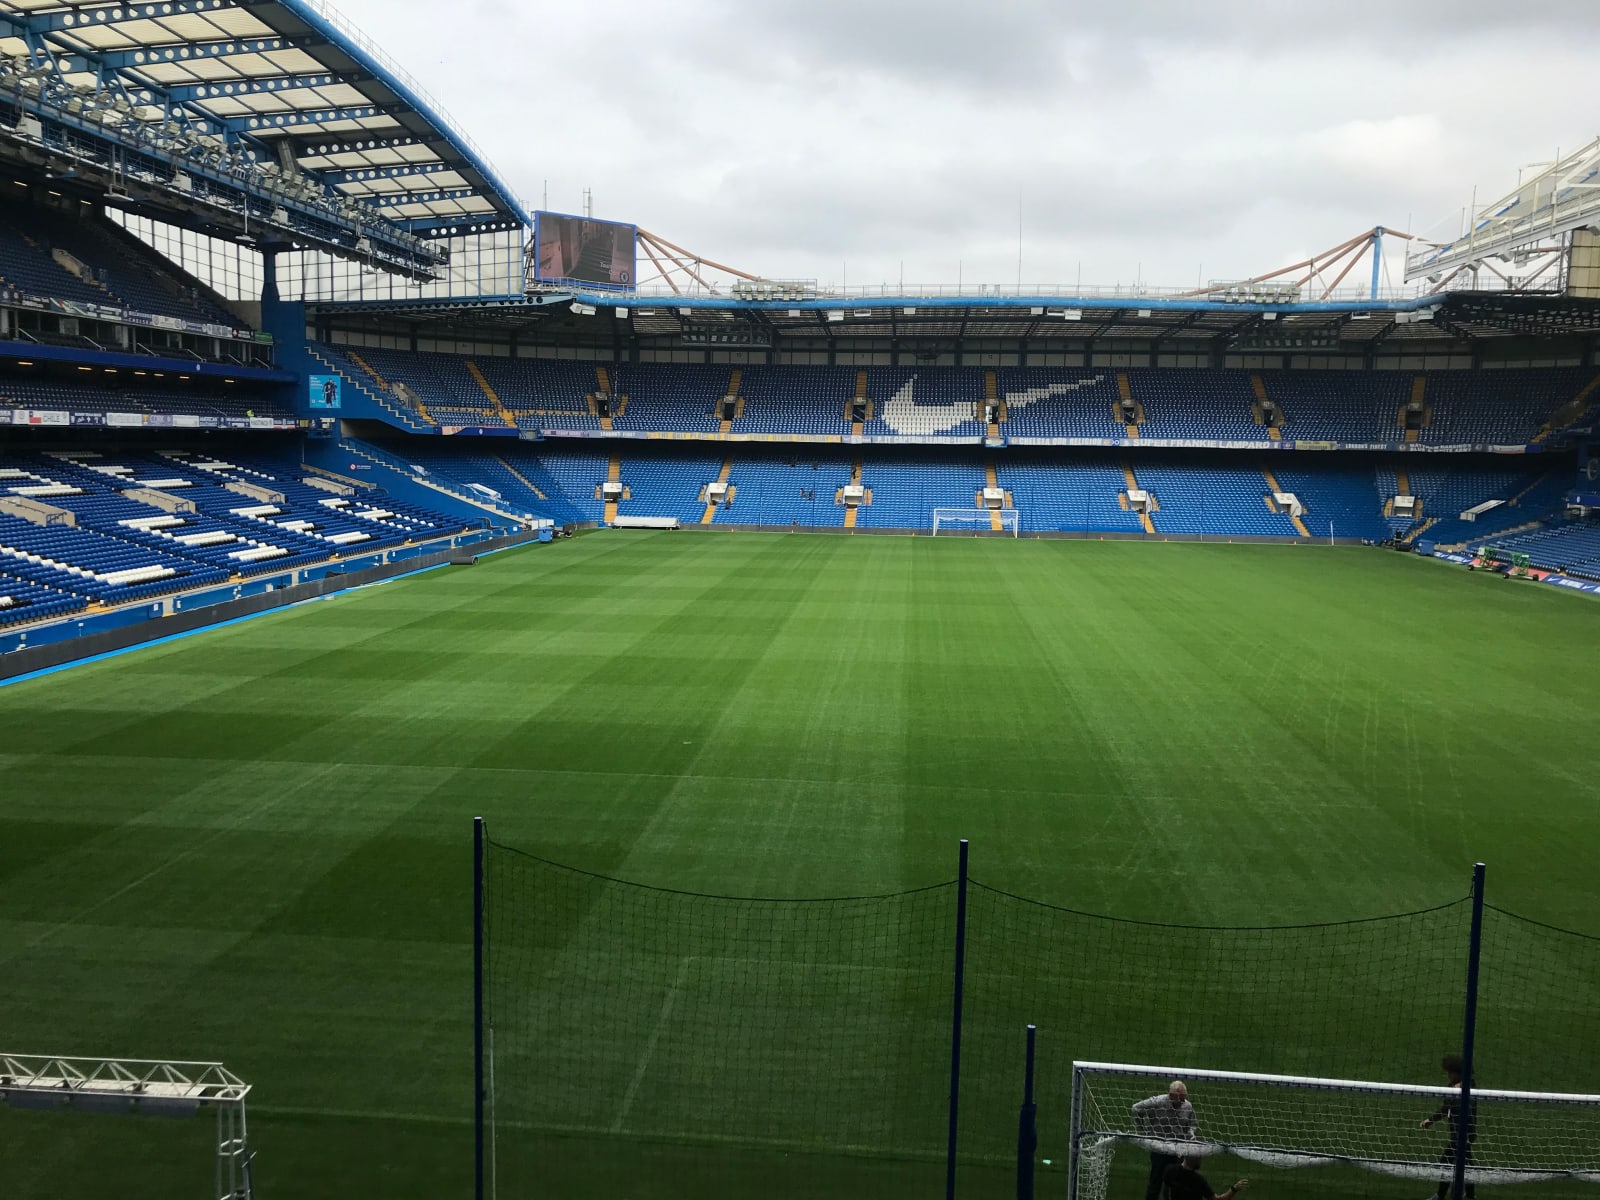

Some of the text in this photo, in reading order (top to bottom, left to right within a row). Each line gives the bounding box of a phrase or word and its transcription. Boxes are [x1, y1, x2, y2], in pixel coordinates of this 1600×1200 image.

[1019, 437, 1050, 445] CHELSEA
[1133, 438, 1270, 449] SUPER FRANKIE LAMPARD
